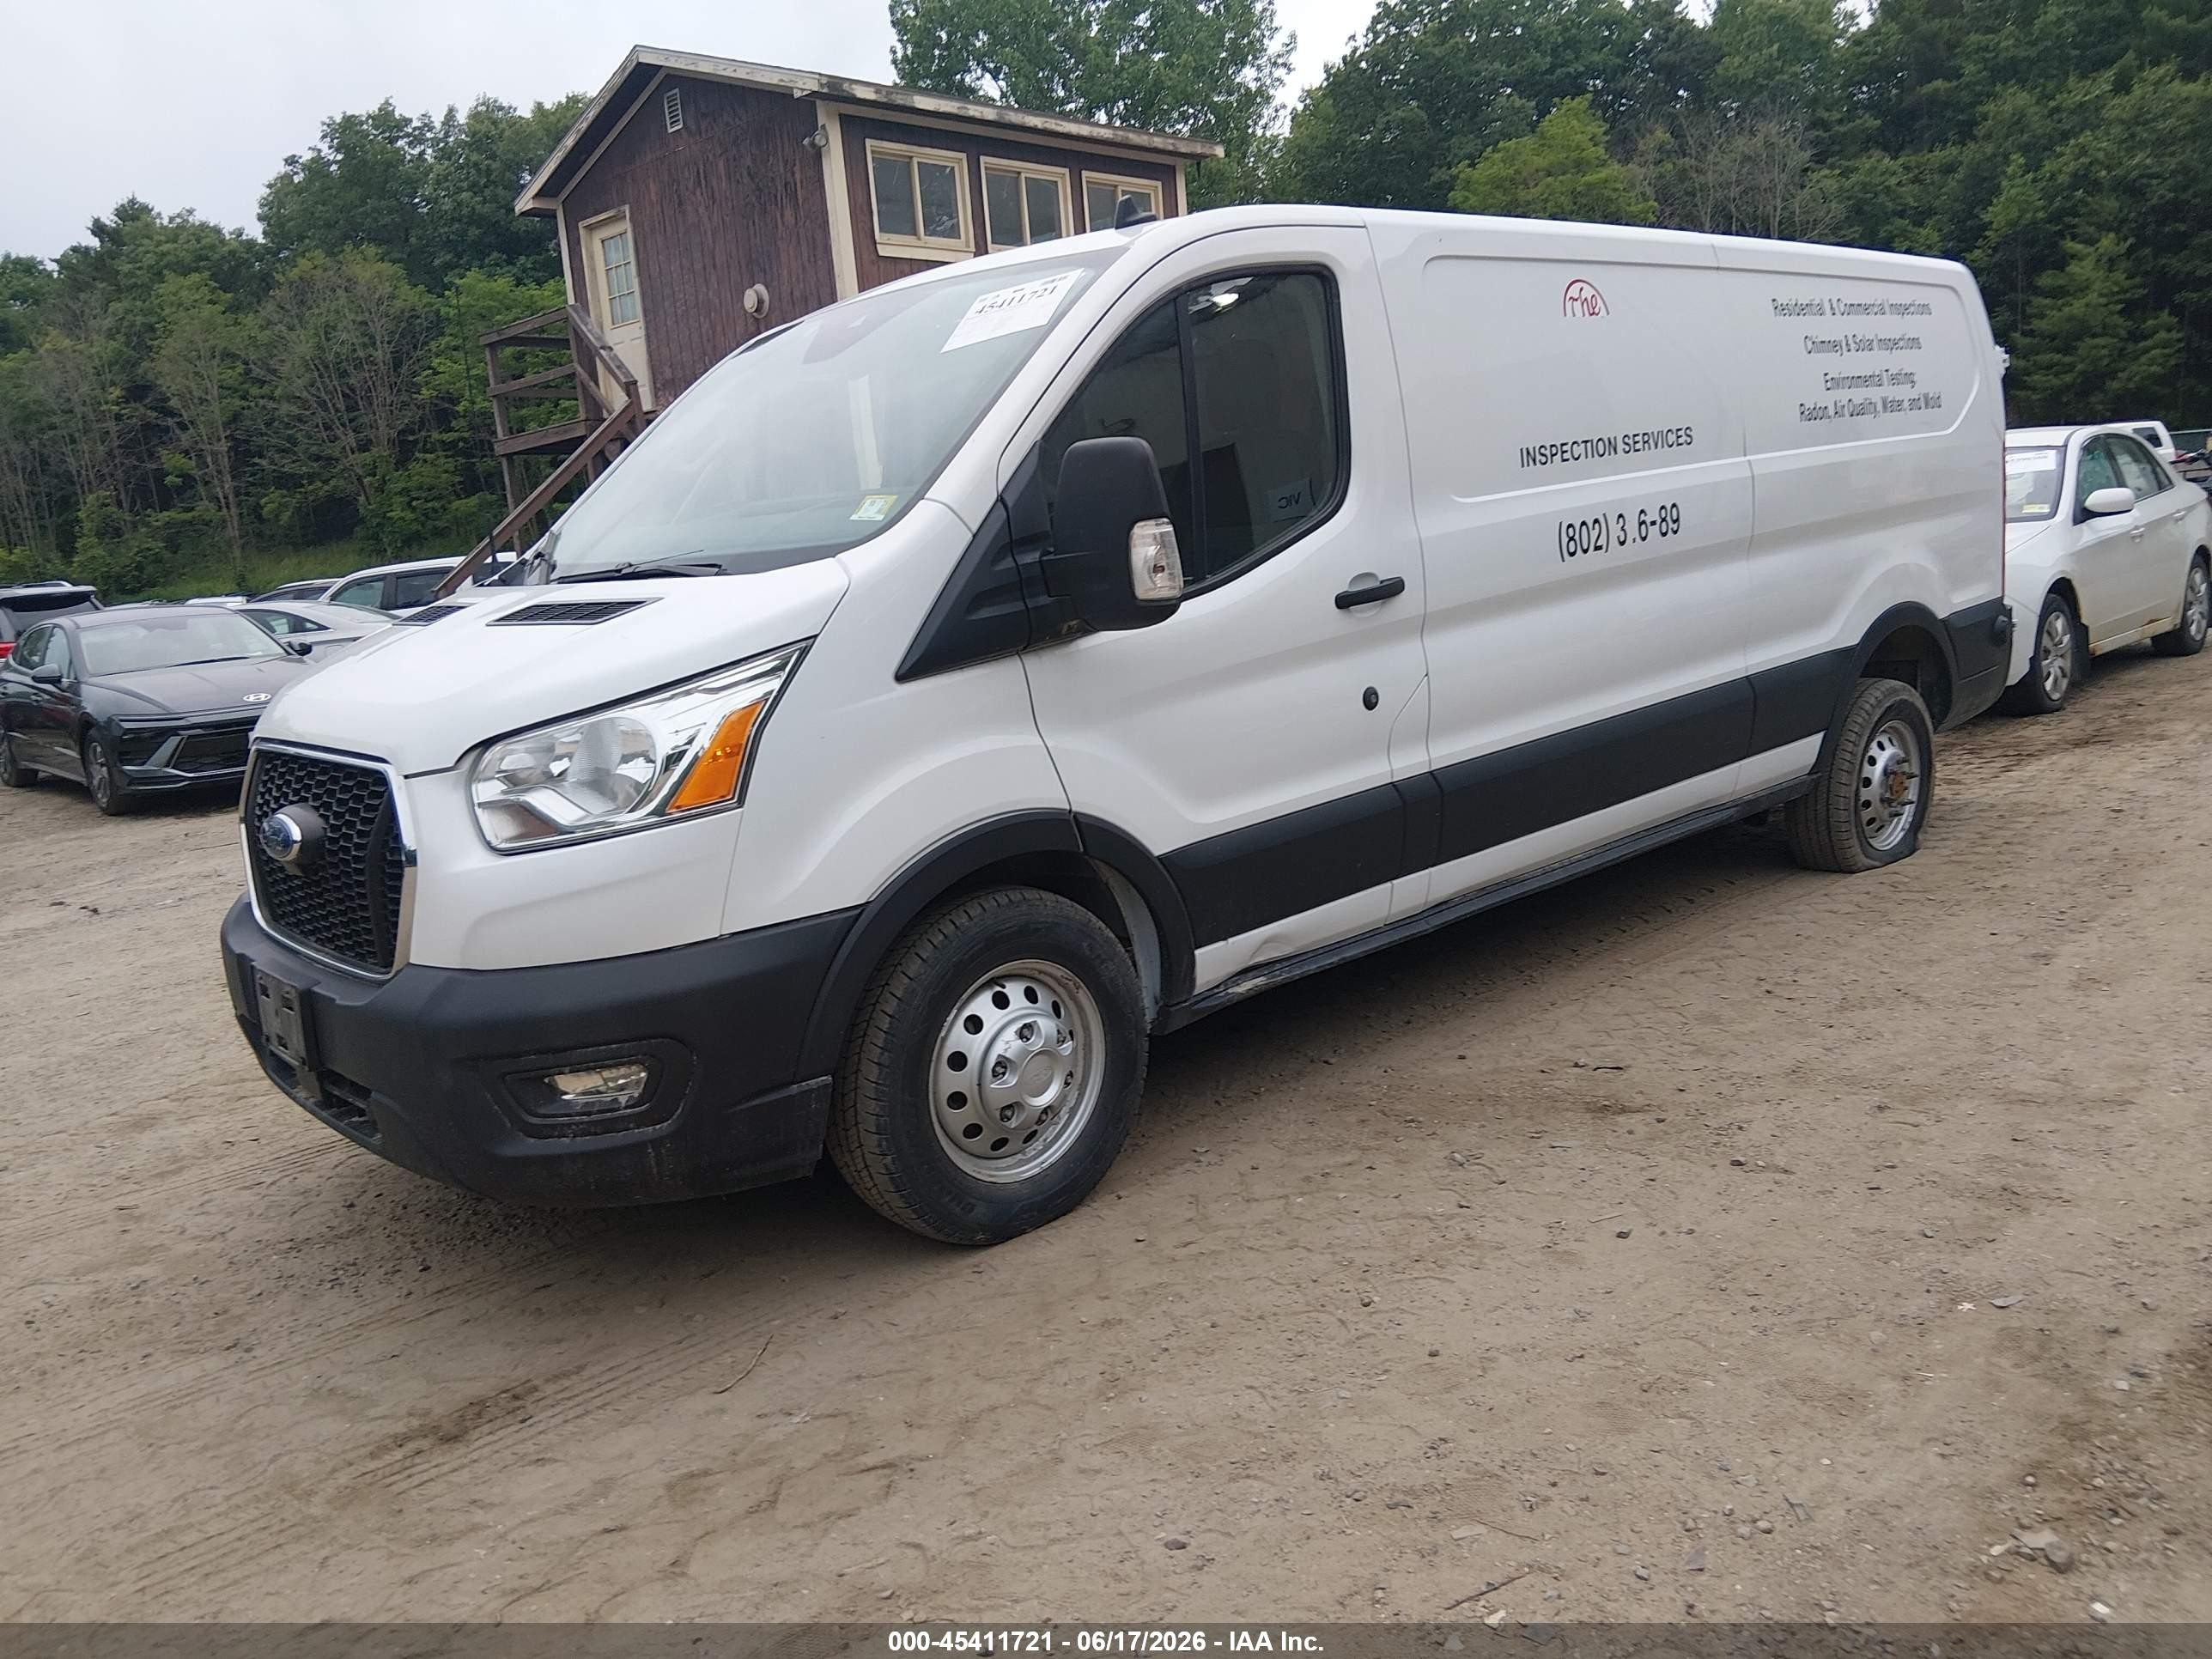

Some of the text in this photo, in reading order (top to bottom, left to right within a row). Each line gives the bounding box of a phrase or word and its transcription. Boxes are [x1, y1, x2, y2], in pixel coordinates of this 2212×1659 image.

[975, 285, 1058, 315] 45411721
[1772, 298, 1826, 317] Residential
[1837, 298, 1887, 316] Commercial
[1887, 298, 1932, 319] Inspections
[1803, 335, 1844, 356] Chimney
[1852, 333, 1875, 352] Solar
[1875, 331, 1923, 353] Inspections
[1823, 370, 1884, 391] Environmental
[1799, 401, 1832, 422] Radon,
[1832, 398, 1846, 418] Air
[1908, 392, 1923, 411] and
[1923, 392, 1942, 410] Mold
[1520, 426, 1693, 468] INSPECTION SERVICES
[1558, 513, 1610, 562] (802)
